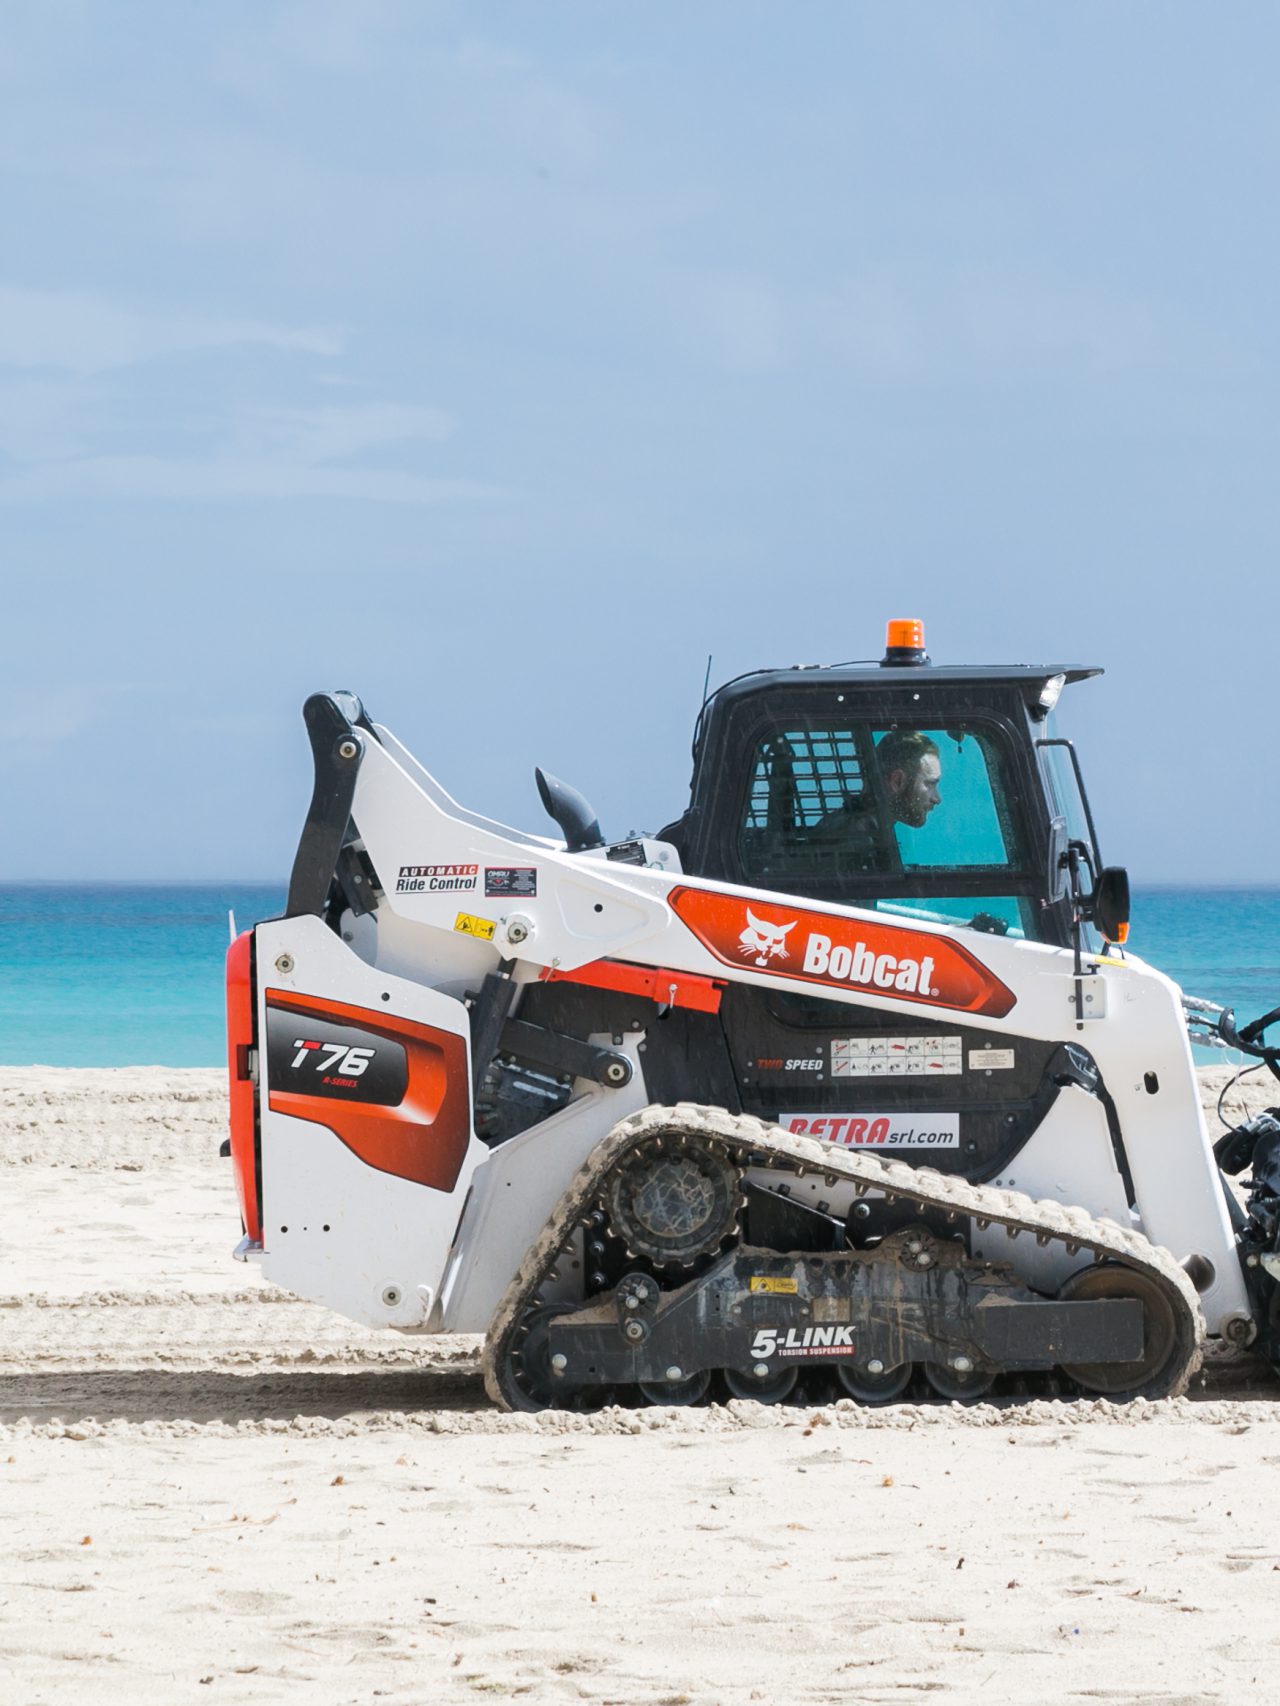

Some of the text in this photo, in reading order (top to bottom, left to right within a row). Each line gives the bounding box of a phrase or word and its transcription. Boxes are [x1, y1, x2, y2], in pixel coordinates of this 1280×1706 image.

[401, 865, 477, 877] AUTOMATIC
[396, 877, 477, 891] Ride Control
[291, 1040, 376, 1076] T76
[757, 1059, 824, 1071] TWO SPEED
[750, 1326, 856, 1359] 5-LINK
[810, 1347, 853, 1355] SUSPENSION
